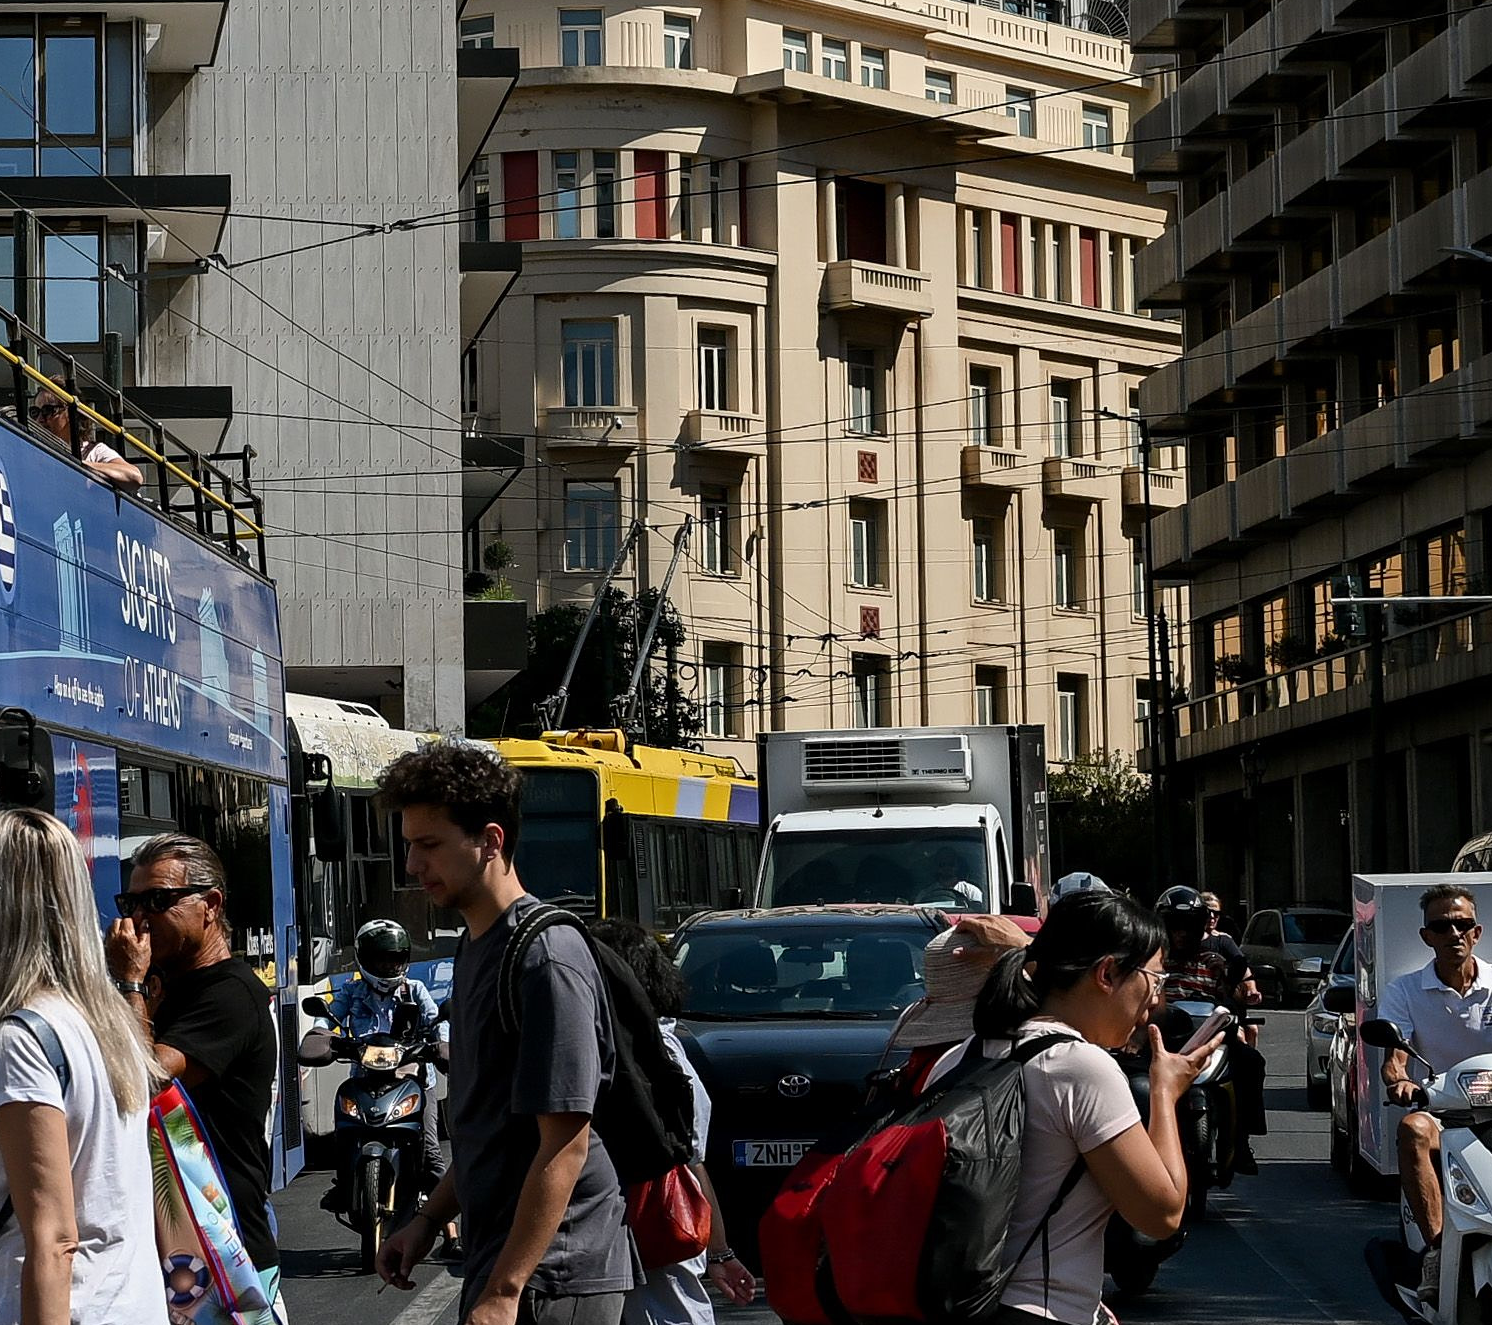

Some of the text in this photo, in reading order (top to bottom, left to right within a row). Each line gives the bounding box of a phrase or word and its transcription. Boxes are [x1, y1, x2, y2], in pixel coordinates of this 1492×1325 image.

[115, 530, 177, 645] SIGHTS
[124, 655, 182, 731] OF ATHENS
